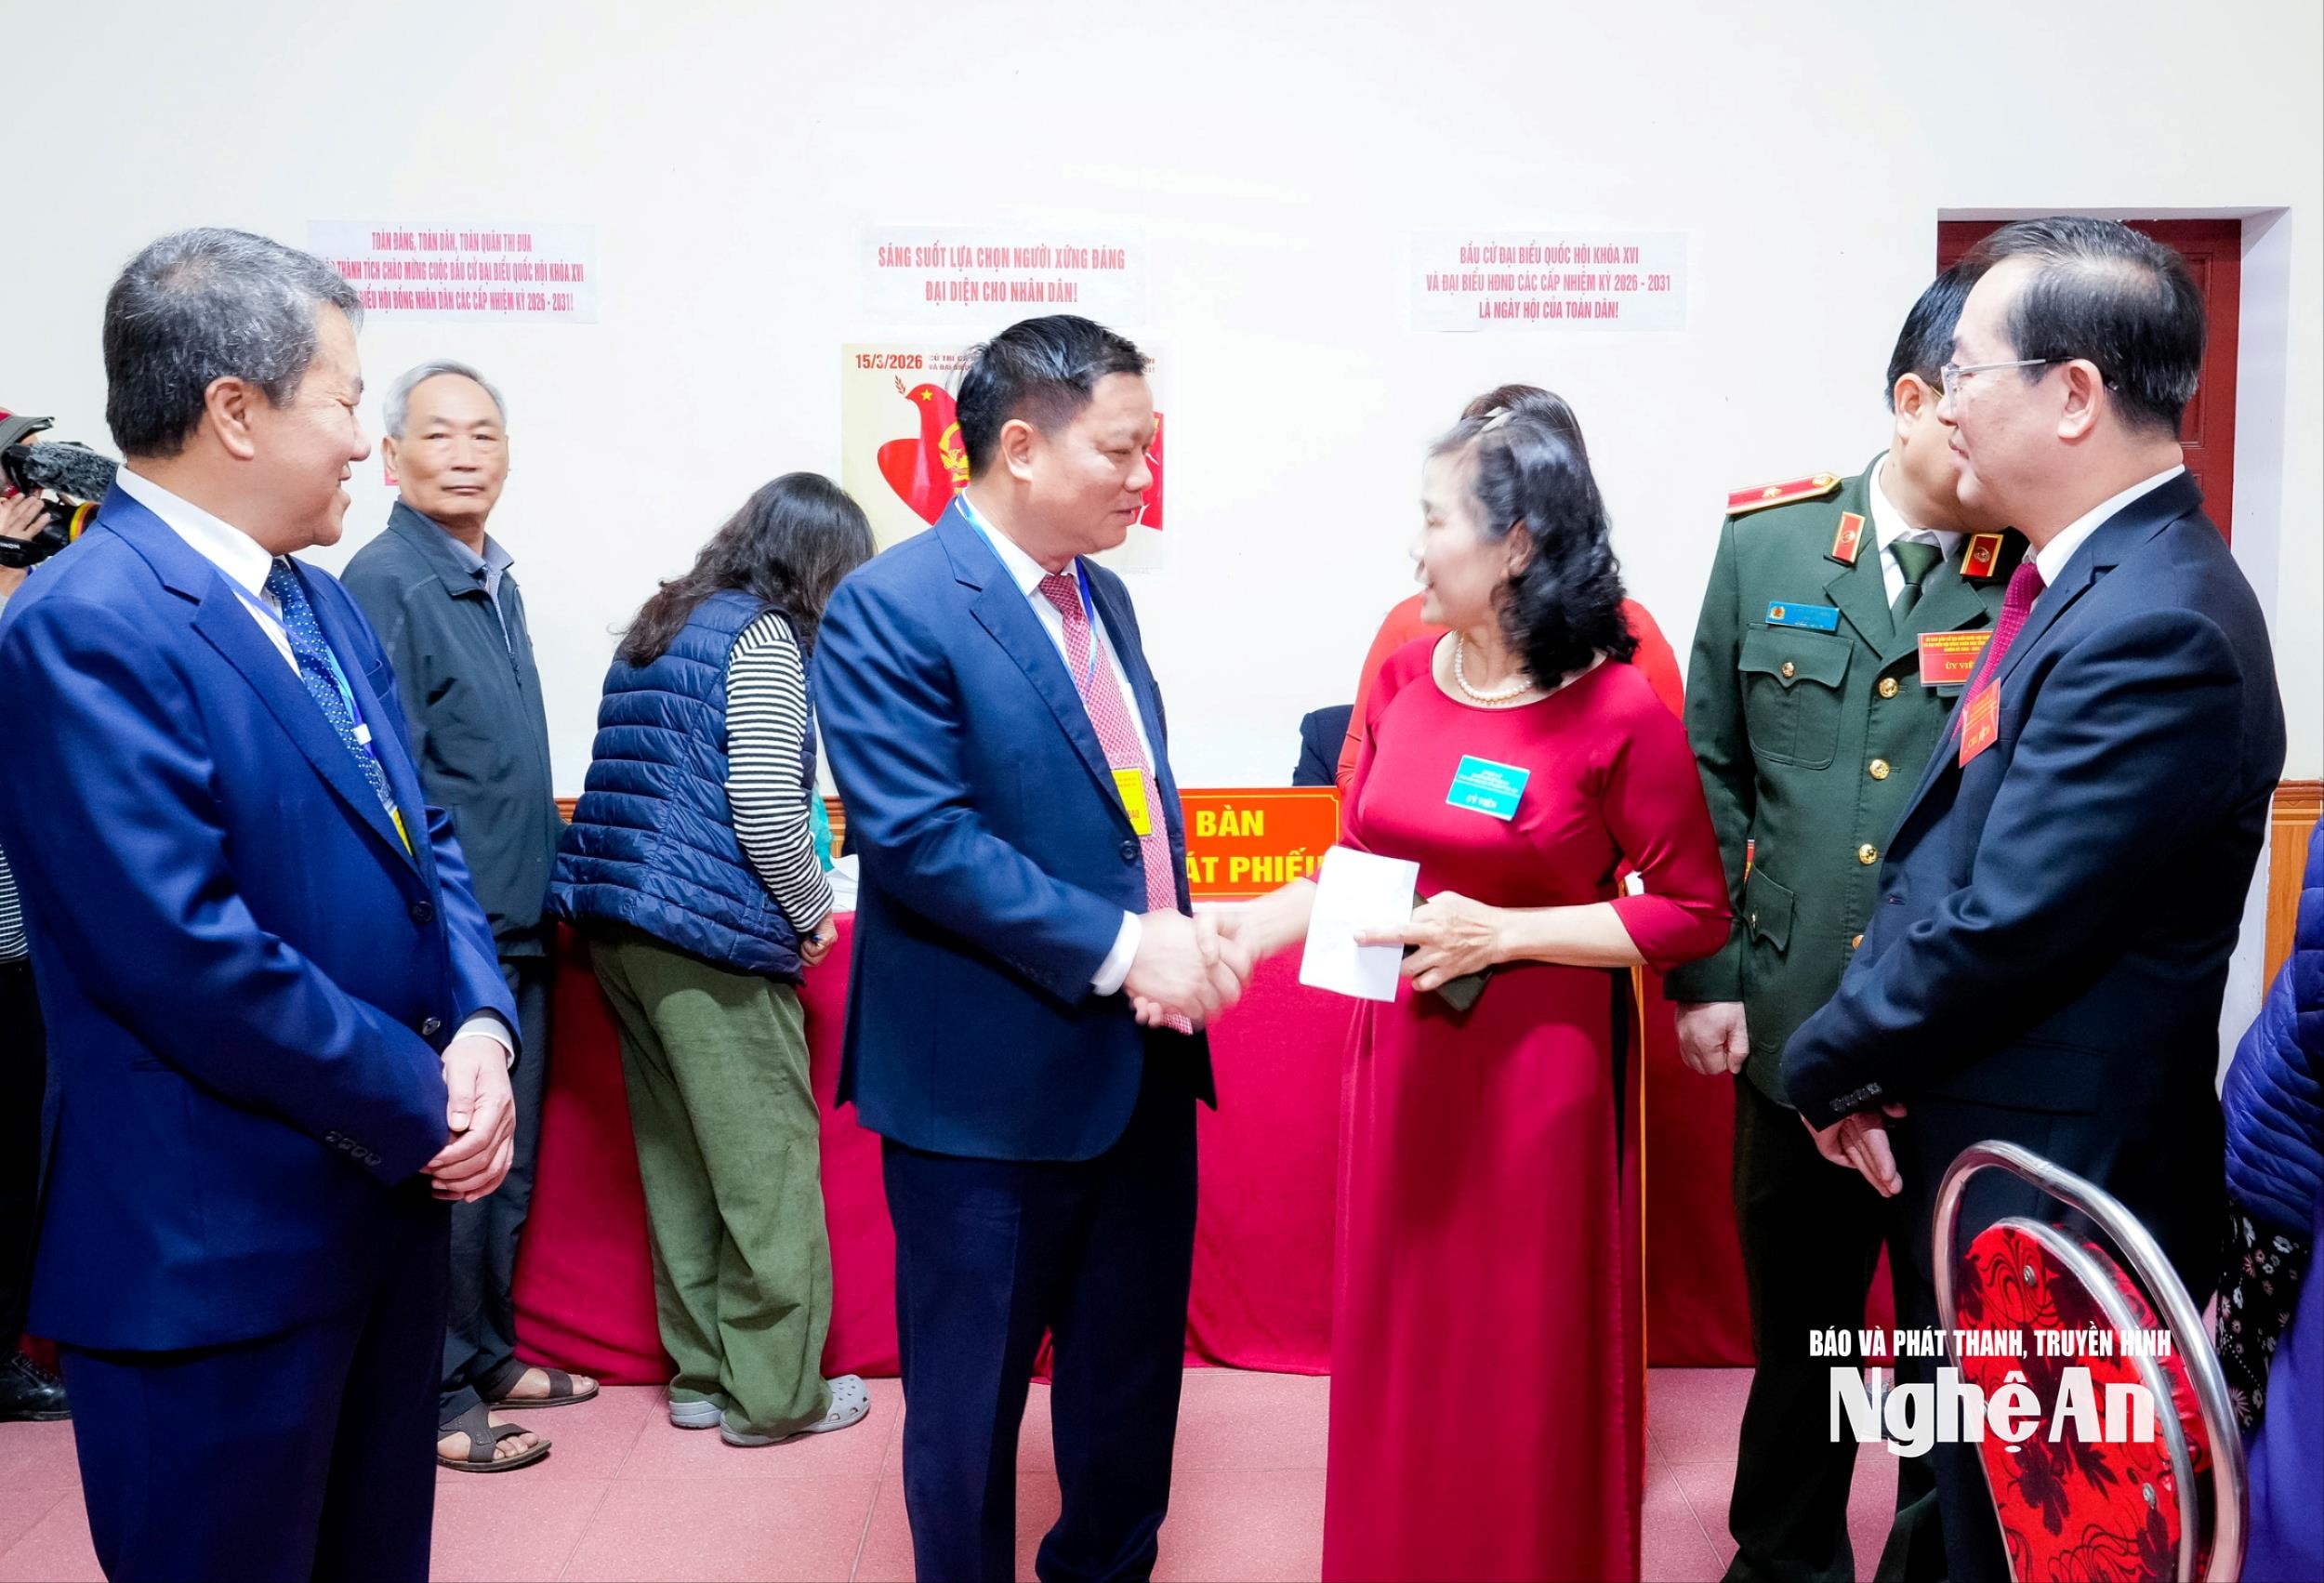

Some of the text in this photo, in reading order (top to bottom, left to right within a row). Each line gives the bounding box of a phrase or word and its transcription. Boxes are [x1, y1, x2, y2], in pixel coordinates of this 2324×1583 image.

[503, 233, 515, 252] THI
[878, 240, 1125, 272] SÁNG SUỐT LỰA CHỌN NGƯỜI XỨNG ĐÁNG
[1499, 246, 1516, 268] ĐẠI
[1544, 240, 1571, 266] QUỐC
[1574, 244, 1591, 268] HỘI
[1593, 243, 1620, 265] KHÓA
[1623, 246, 1639, 265] XVI
[926, 277, 1078, 307] ĐẠI DIỆN CHO NHÂN DÂN!
[1426, 270, 1440, 292] VÀ
[1442, 274, 1459, 296] ĐẠI
[1462, 267, 1485, 292] BIỂU
[1487, 274, 1515, 292] HĐND
[1518, 270, 1538, 292] CÁC
[1541, 267, 1559, 292] CẤP
[1564, 270, 1595, 296] NHIỆM
[1599, 270, 1611, 292] KỲ
[1614, 274, 1638, 292] 2026
[1648, 274, 1670, 292] 2031
[527, 293, 546, 311] 2026
[1479, 295, 1618, 323] LÀ NGÀY HỘI CỦA TOÀN DÂN!
[855, 353, 923, 369] 15/3/2026
[1959, 659, 1974, 670] VIÊ
[1196, 804, 1264, 838] BÀN
[1185, 851, 1220, 883] ÁT
